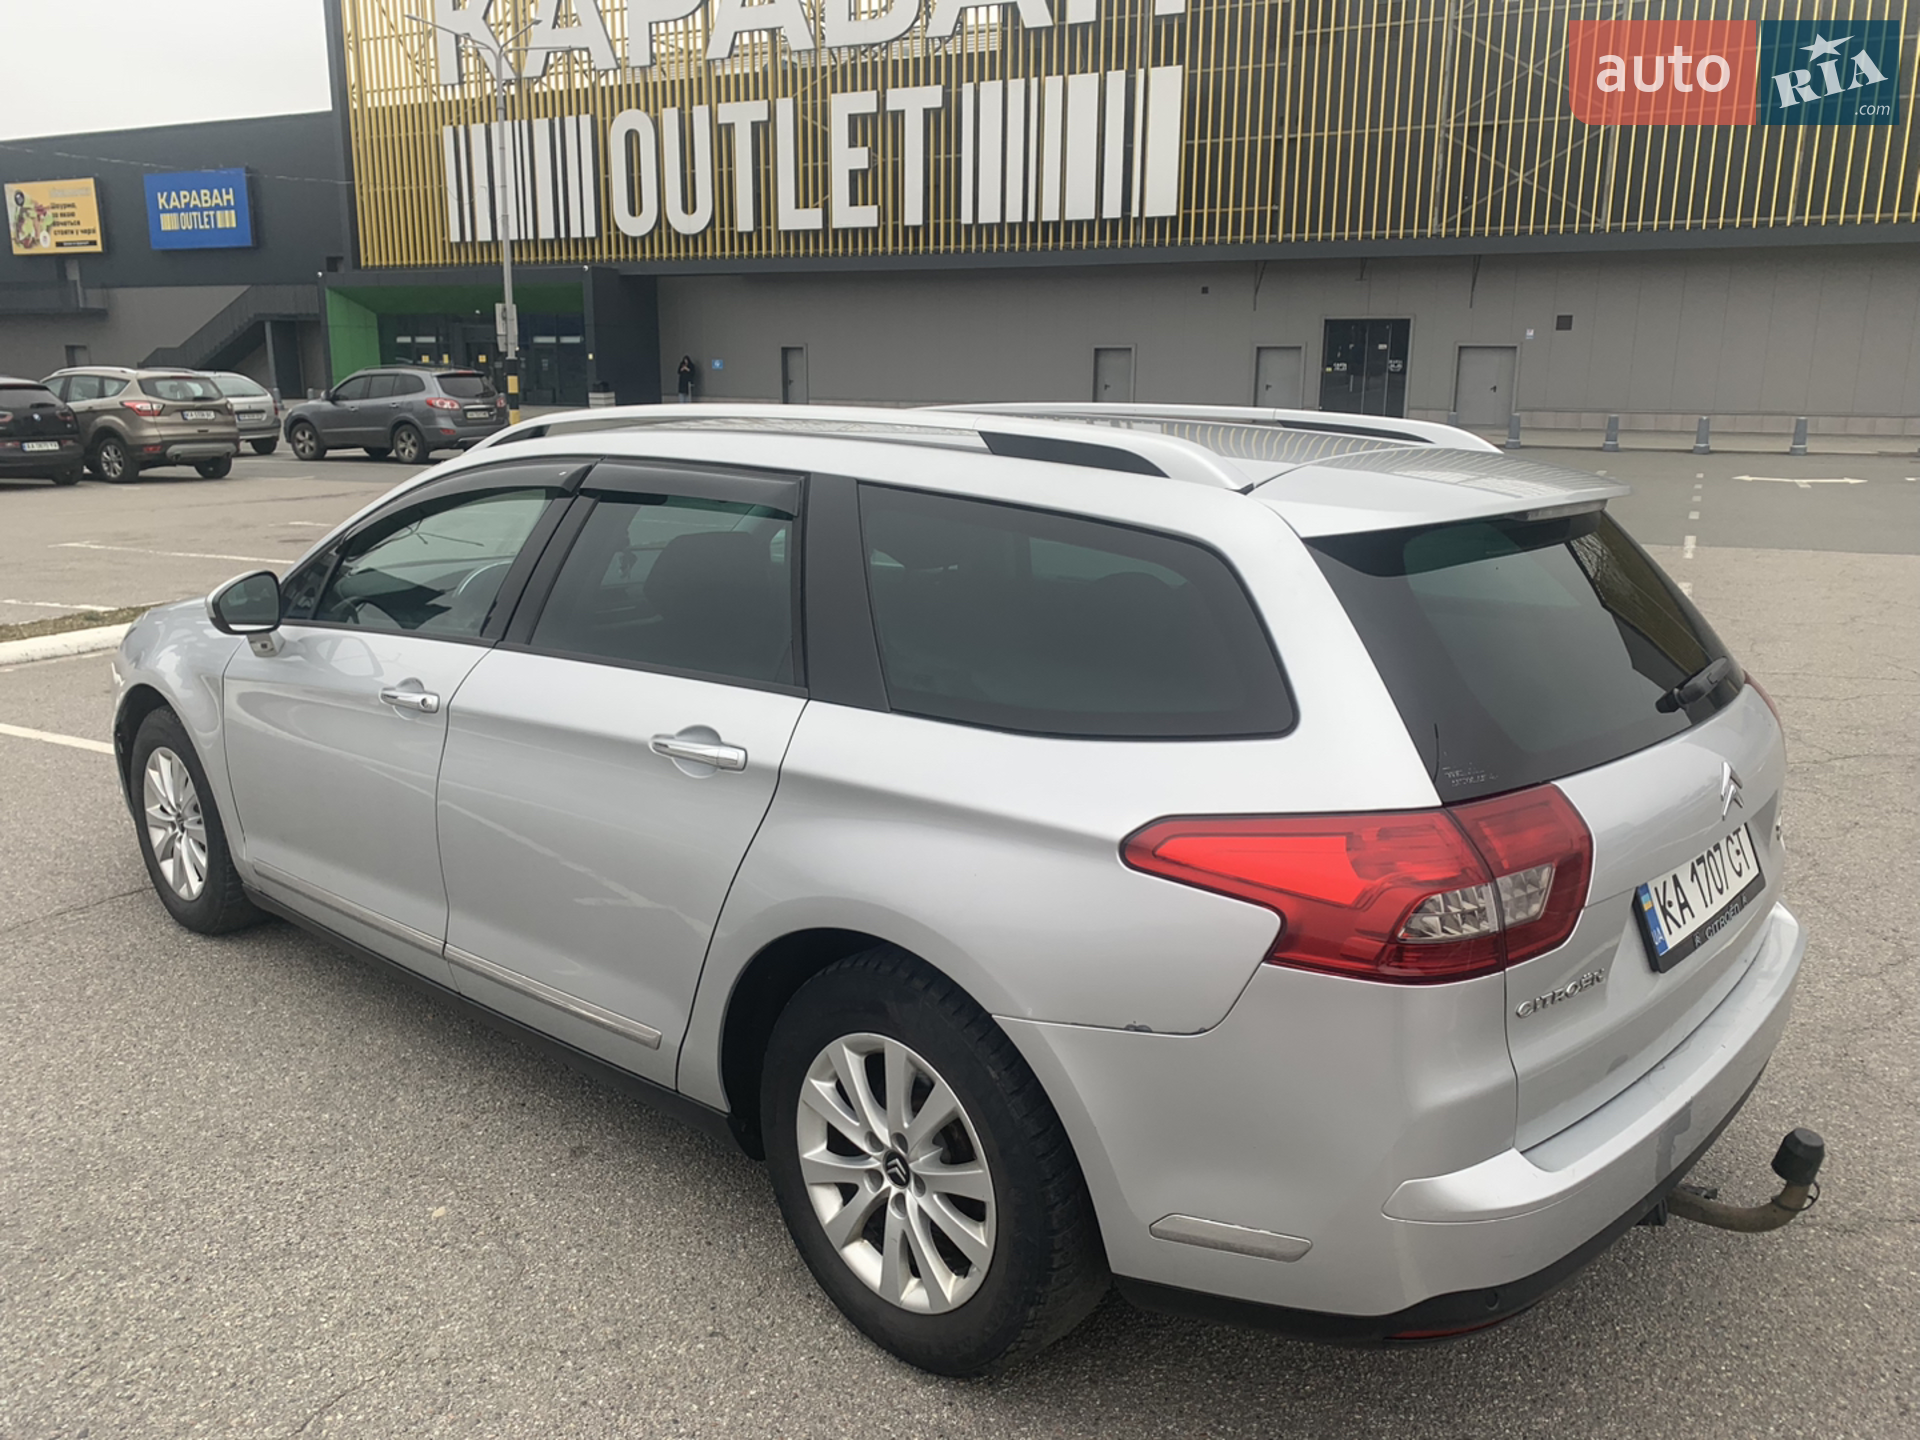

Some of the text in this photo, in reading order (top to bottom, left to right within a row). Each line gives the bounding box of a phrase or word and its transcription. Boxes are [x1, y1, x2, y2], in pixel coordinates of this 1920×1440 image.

[609, 85, 943, 238] OUTLET
[157, 187, 235, 210] КАРАВАН
[180, 211, 215, 230] OUTLET
[1654, 827, 1751, 936] KA 1707 CT
